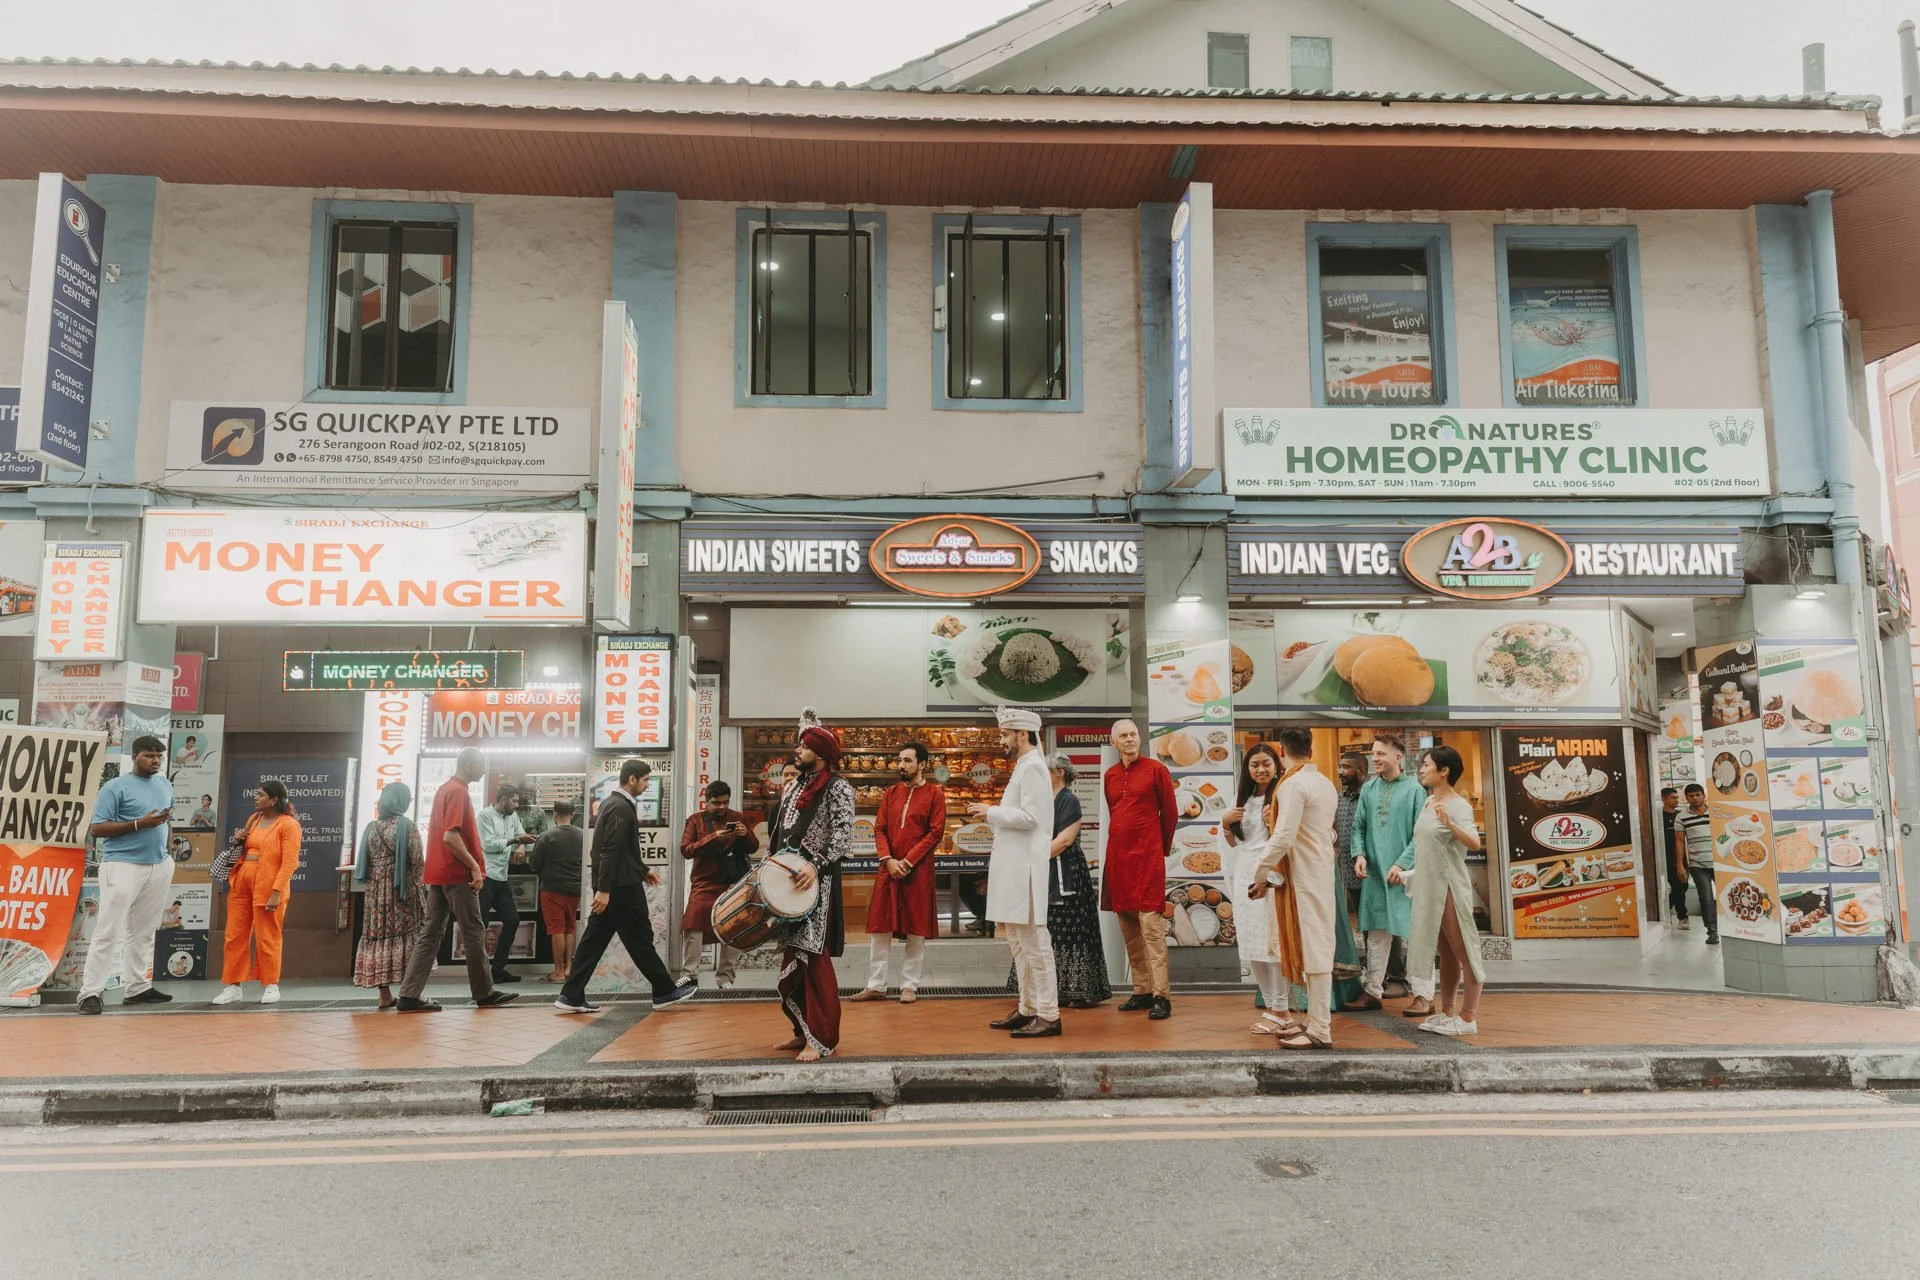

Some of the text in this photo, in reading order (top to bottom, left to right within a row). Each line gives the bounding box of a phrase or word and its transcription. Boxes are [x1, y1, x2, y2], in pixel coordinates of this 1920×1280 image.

[60, 253, 96, 285] EDURIOUS
[57, 265, 98, 299] EDUCATION
[1176, 240, 1186, 341] SNACKS
[62, 284, 91, 309] CENTRE
[1326, 293, 1369, 308] Exciting
[78, 323, 95, 338] LEVEL
[1392, 313, 1426, 329] Enjoy!
[73, 329, 89, 344] LEVEL
[60, 341, 84, 360] SCIENCE
[1180, 344, 1187, 361] &
[55, 368, 85, 391] Contact:
[1516, 379, 1620, 402] Air Ticketing
[51, 380, 85, 404] 85421242
[273, 411, 559, 436] SG QUICKPAY PTE LTD
[1179, 367, 1187, 467] SWEETS
[53, 422, 78, 440] #02-06
[1469, 423, 1593, 441] NATURES
[47, 432, 82, 454] (2nd floor)
[299, 439, 526, 453] 276 Serangoon Road #02-02, S(218105)
[298, 454, 545, 469] +65-8798 4750, 8549 4750 info@sgquickpay.com
[1286, 446, 1710, 474] HOMEOPATHY CLINIC
[236, 474, 519, 490] An International Remittance Service Provider in Singapore
[1237, 479, 1260, 487] MON
[1268, 479, 1283, 487] FRI
[1289, 479, 1311, 488] 5pm
[1318, 479, 1355, 488] 7.30pm,
[1440, 480, 1476, 489] 7.30pm
[1533, 480, 1616, 488] CALL 9006-5540
[1675, 478, 1761, 488] #02-05 (2nd floor)
[294, 519, 430, 531] SIRADJ EXCHANGE
[57, 549, 121, 559] SIRADJ EXCHANGE
[164, 541, 385, 573] MONEY
[688, 540, 860, 573] INDIAN SWEETS
[896, 549, 1016, 565] Sweets & Snacks
[1049, 540, 1137, 573] SNACKS
[1441, 523, 1524, 570] A2B
[1240, 542, 1397, 575] INDIAN VEG.
[1574, 543, 1738, 575] RESTAURANT
[265, 579, 566, 608] CHANGER
[48, 561, 78, 654] MONEY
[83, 560, 110, 653] CHANGER
[634, 641, 669, 650] EXCHANGE
[66, 665, 97, 676] ABM
[323, 664, 485, 678] MONEY CHANGER
[505, 693, 553, 705] SIRADJ
[604, 653, 629, 744] MONEY
[637, 653, 661, 743] CHANGER
[170, 719, 204, 729] TE LTD
[432, 712, 535, 738] MONEY
[699, 690, 713, 741] 货币兑换
[1519, 739, 1608, 757] Plain NAAN
[260, 775, 293, 783] SPACE
[0, 797, 85, 844] ANGER
[1551, 817, 1584, 837] A2B
[9, 865, 74, 896] BANK
